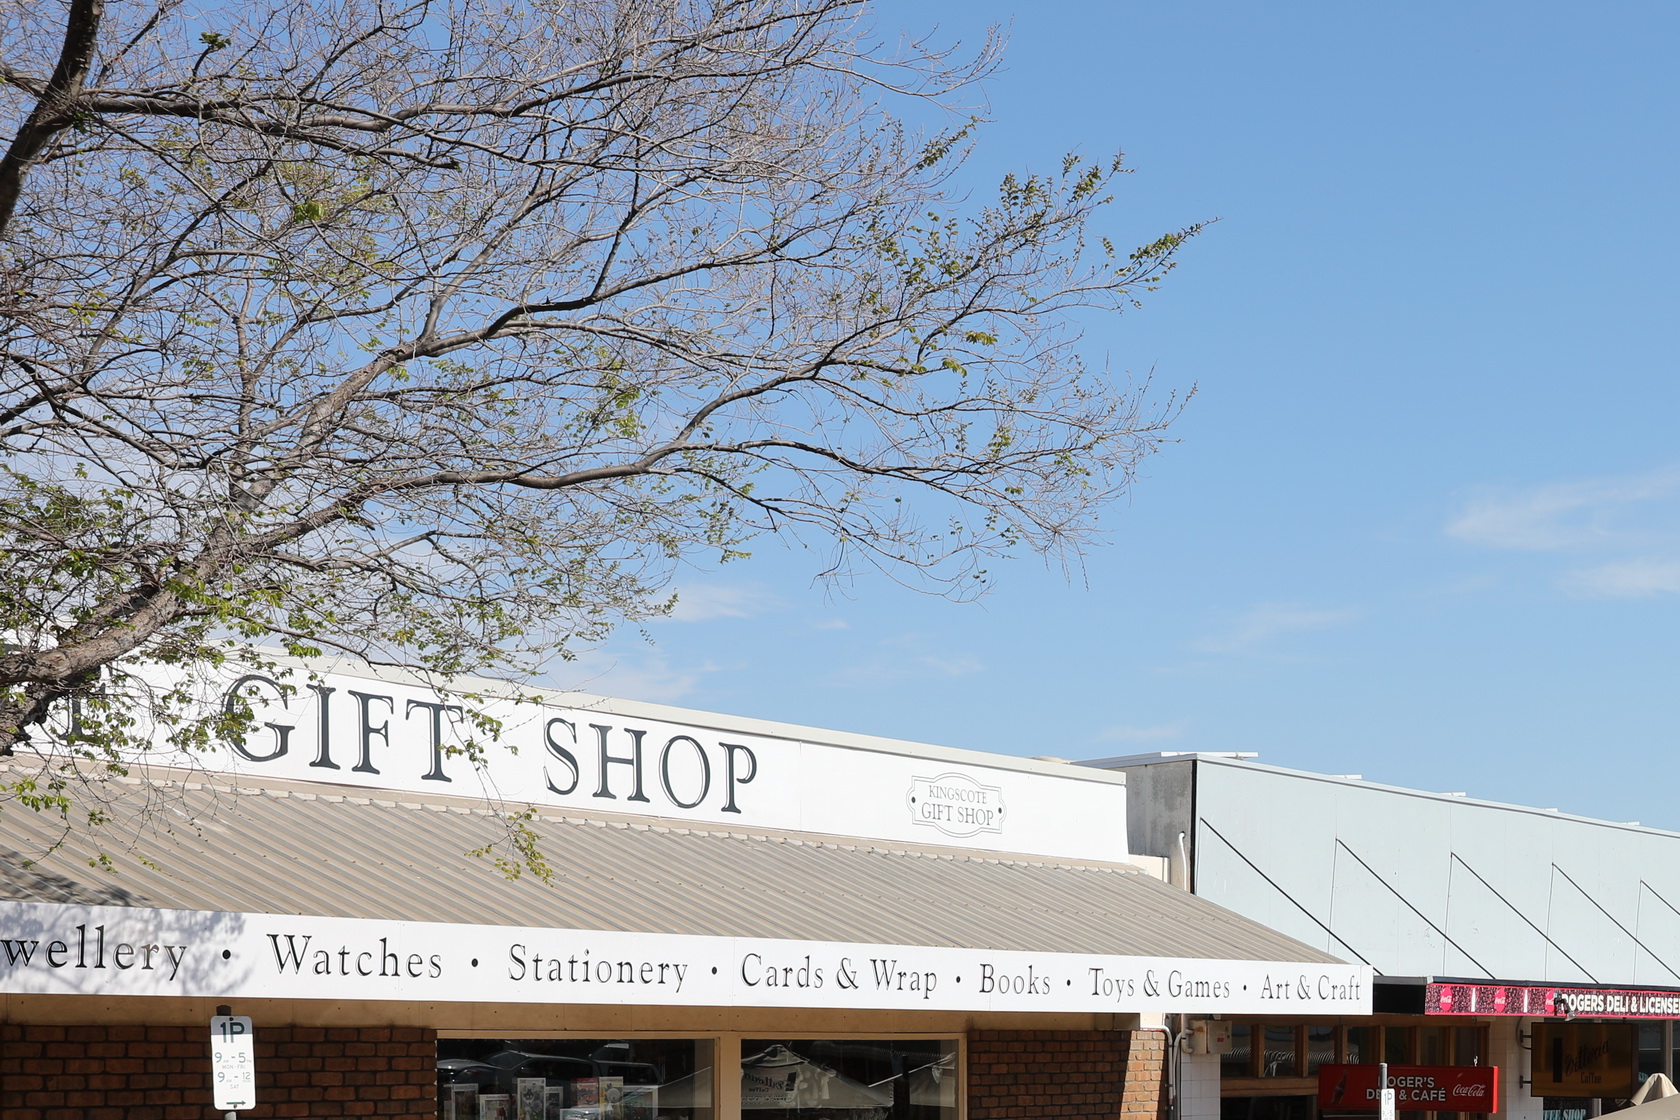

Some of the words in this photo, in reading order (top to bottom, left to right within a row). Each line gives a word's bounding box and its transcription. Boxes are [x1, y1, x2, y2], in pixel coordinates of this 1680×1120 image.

[223, 674, 464, 783] GIFT
[543, 716, 760, 815] SHOP
[929, 785, 987, 804] KINGSCOTE
[922, 802, 953, 821] GIFT
[958, 806, 993, 826] SHOP
[266, 933, 442, 978] Watches
[508, 943, 688, 993] Stationery
[741, 953, 824, 989] Cards
[834, 957, 860, 990] &
[869, 960, 937, 999] Wrap
[979, 963, 1051, 995] Books
[1088, 967, 1135, 1002] Toys
[1143, 970, 1160, 997] &
[1168, 970, 1230, 999] Games
[1260, 974, 1290, 1000] Art
[1296, 974, 1311, 1000] &
[1318, 974, 1361, 1002] Craft
[1606, 996, 1629, 1013] DELI
[1630, 996, 1639, 1013] &
[220, 1022, 245, 1043] 1P
[1378, 1076, 1435, 1088] OGER'S
[1581, 1072, 1602, 1083] Coffee
[1399, 1089, 1408, 1101] &
[1411, 1087, 1446, 1102] CAFÉ
